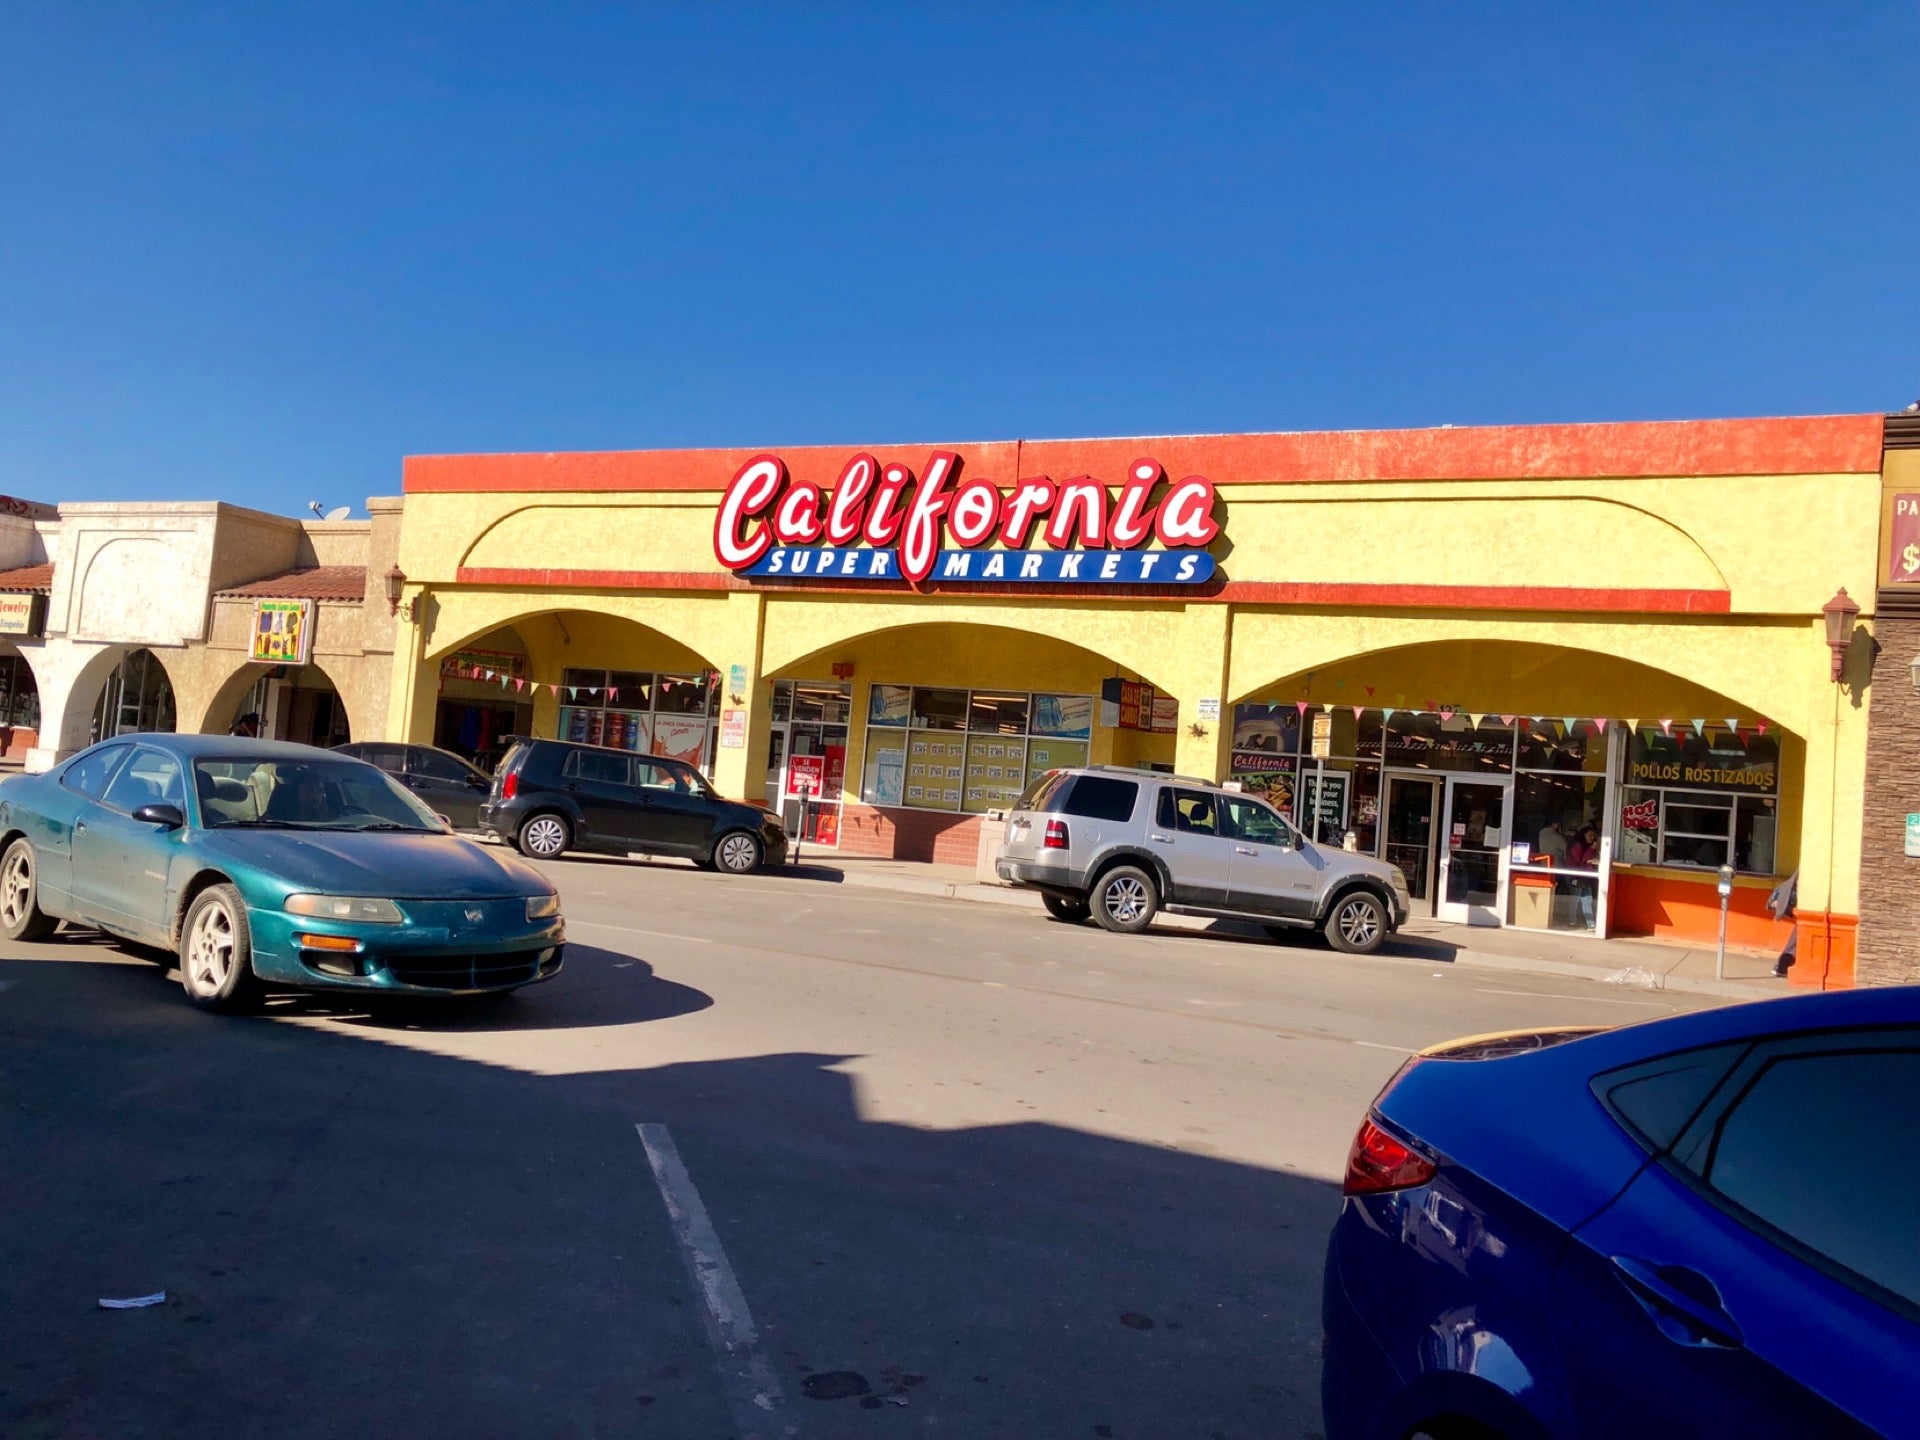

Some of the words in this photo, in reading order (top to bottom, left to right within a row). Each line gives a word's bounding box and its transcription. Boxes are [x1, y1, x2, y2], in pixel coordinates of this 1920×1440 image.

[715, 451, 1219, 582] California
[767, 549, 887, 576] SUPER
[944, 552, 1202, 581] MARKETS
[1234, 755, 1290, 770] California
[1633, 763, 1681, 780] POLLOS
[1685, 767, 1775, 787] ROSTIZADOS
[1622, 799, 1656, 816] HOT
[1622, 815, 1659, 830] DOGS
